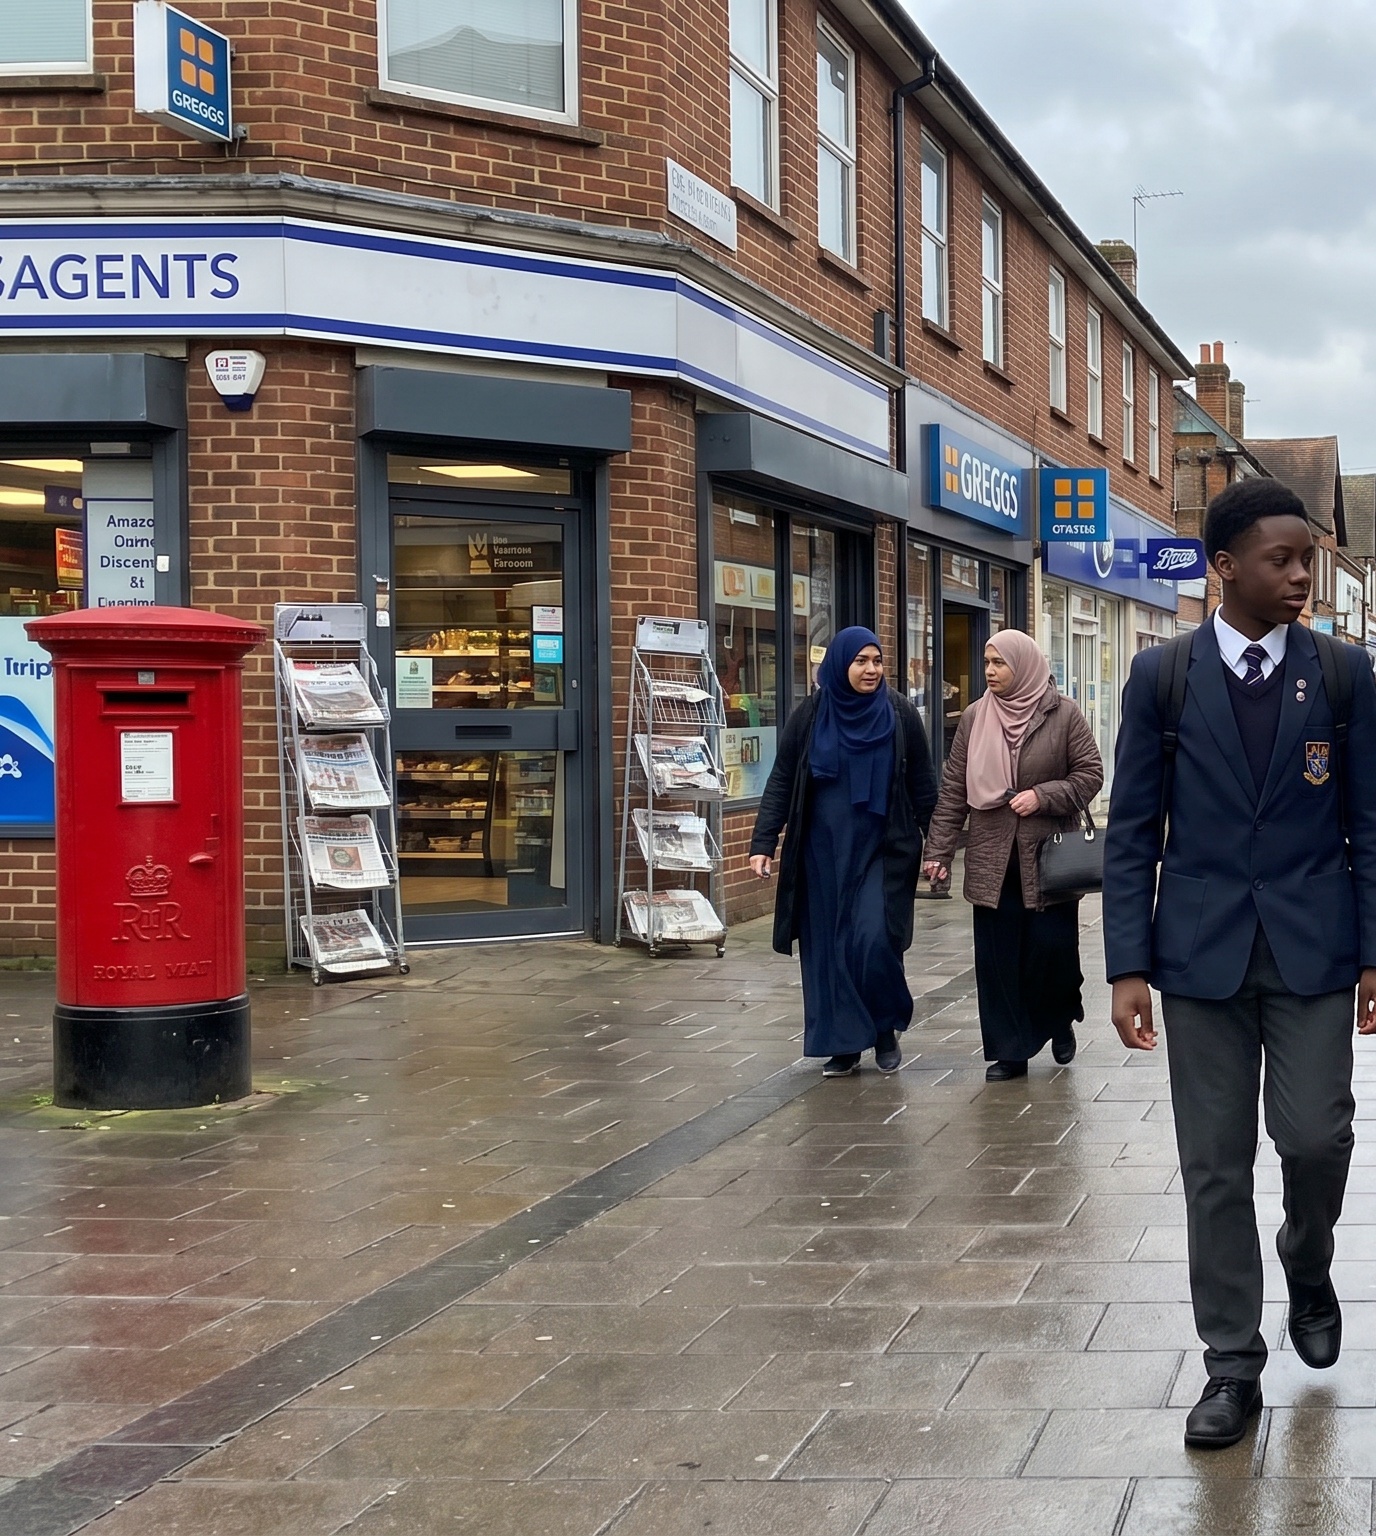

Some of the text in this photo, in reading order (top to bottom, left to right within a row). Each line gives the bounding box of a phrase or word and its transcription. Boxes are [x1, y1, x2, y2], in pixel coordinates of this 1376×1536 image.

[172, 89, 225, 126] GREGGS
[0, 253, 240, 300] AGENTS
[960, 452, 1018, 519] GREGGS
